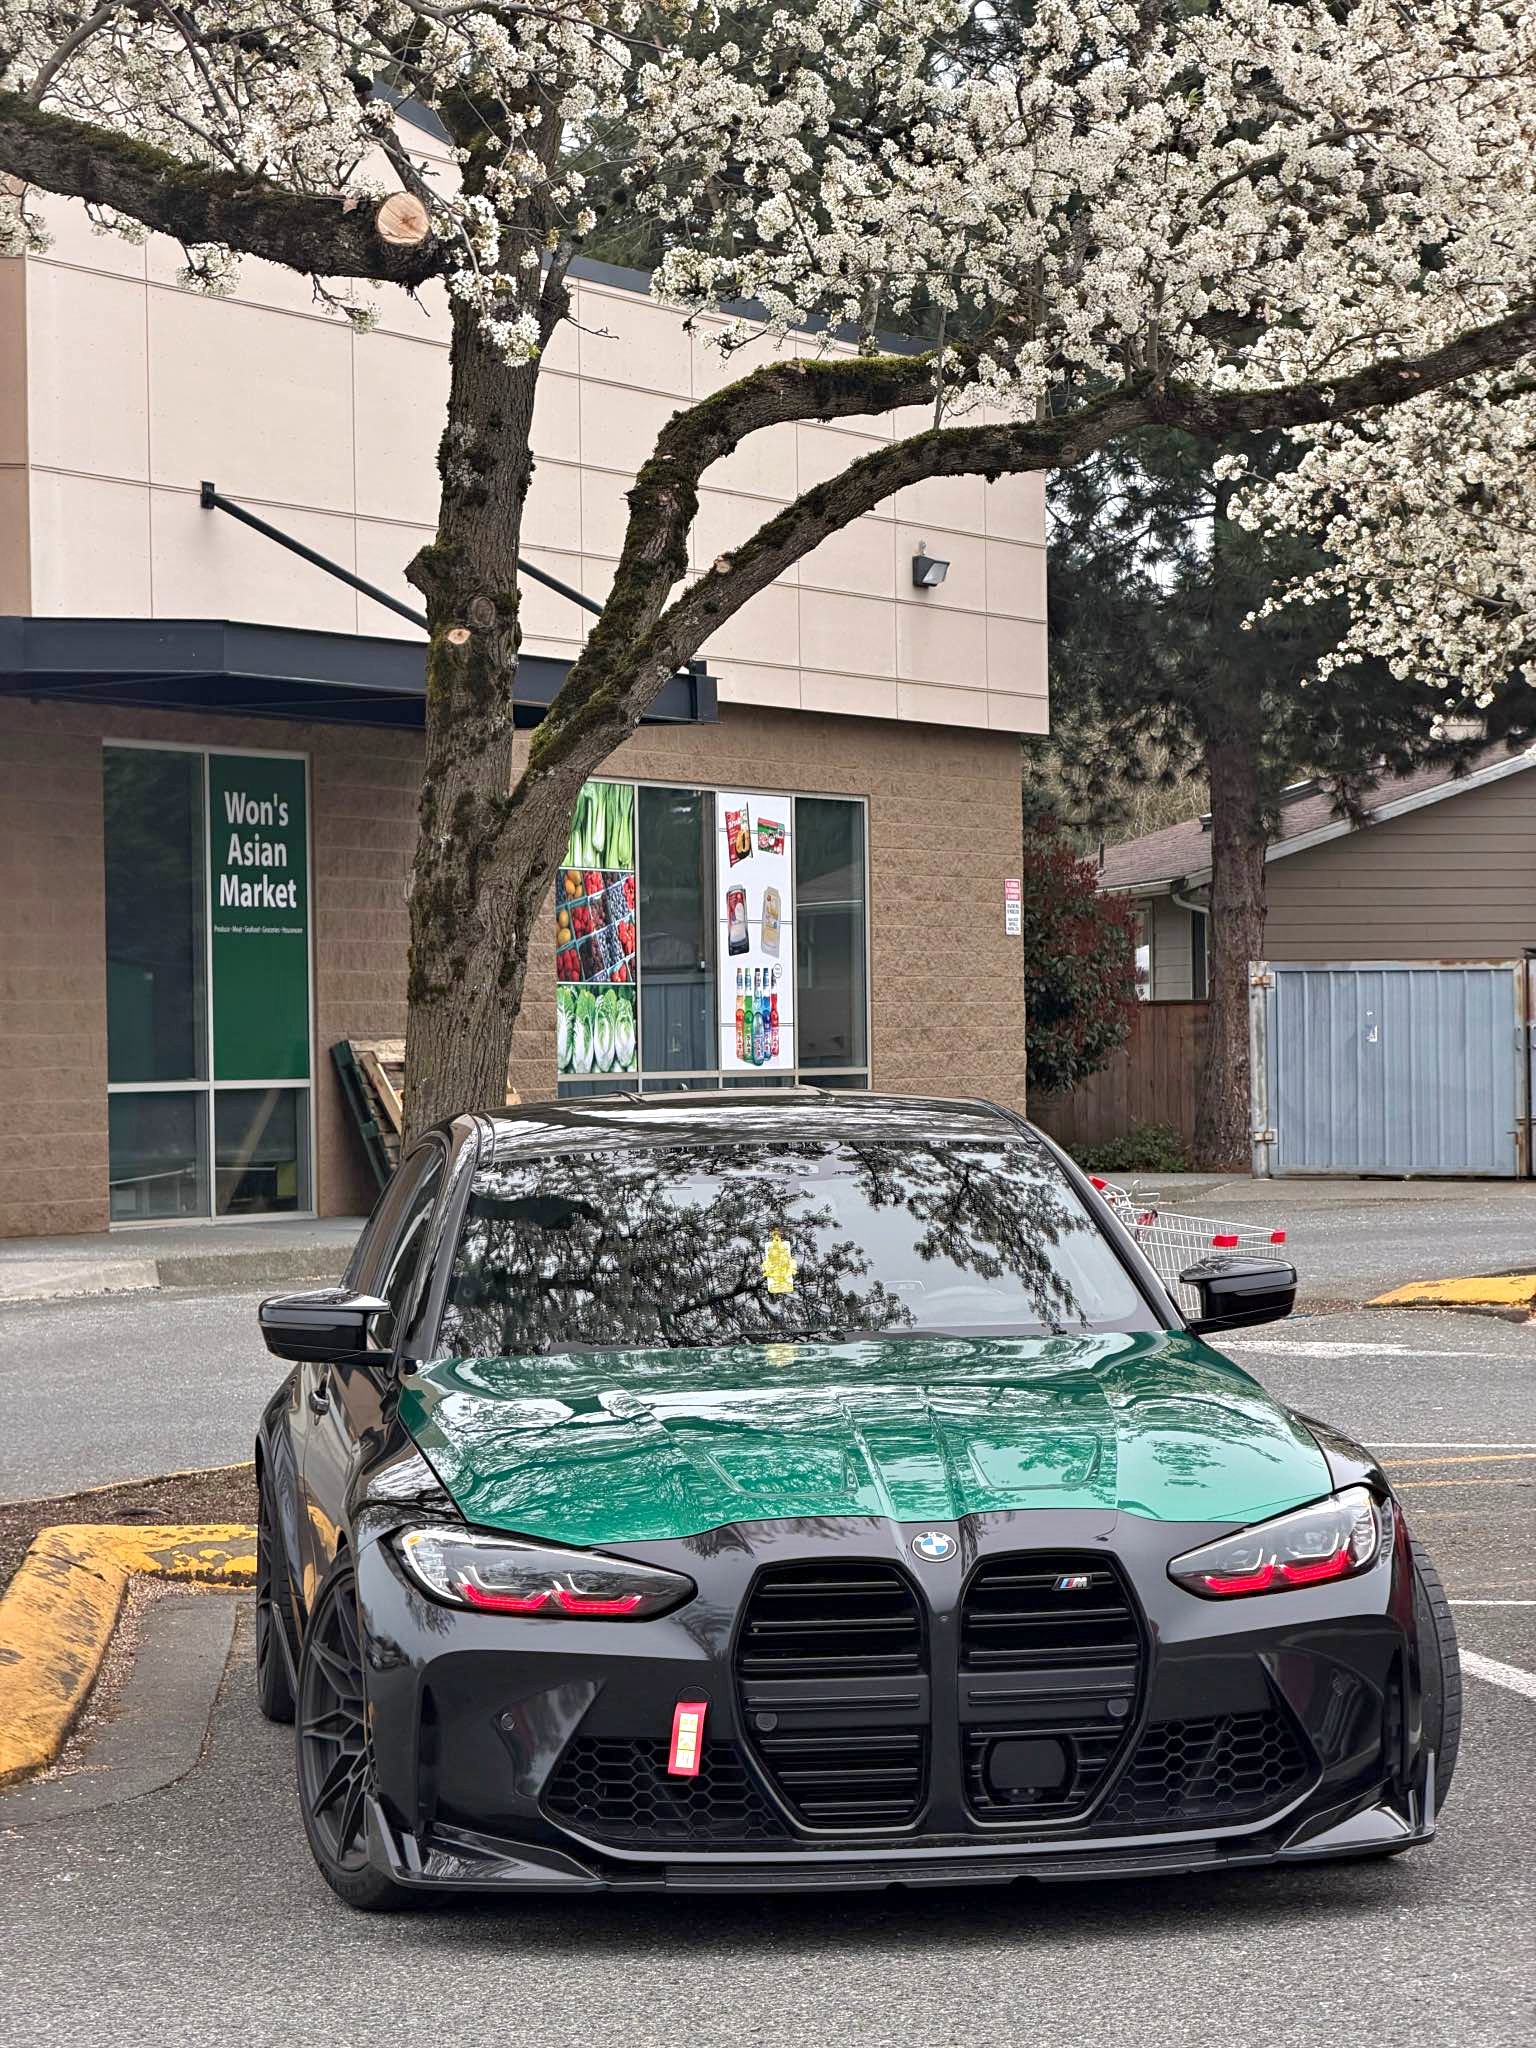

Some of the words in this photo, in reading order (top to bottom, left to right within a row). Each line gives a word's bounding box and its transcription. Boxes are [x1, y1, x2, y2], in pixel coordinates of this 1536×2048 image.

[224, 791, 289, 827] Won's
[227, 832, 288, 867] Asian
[219, 873, 297, 909] Market
